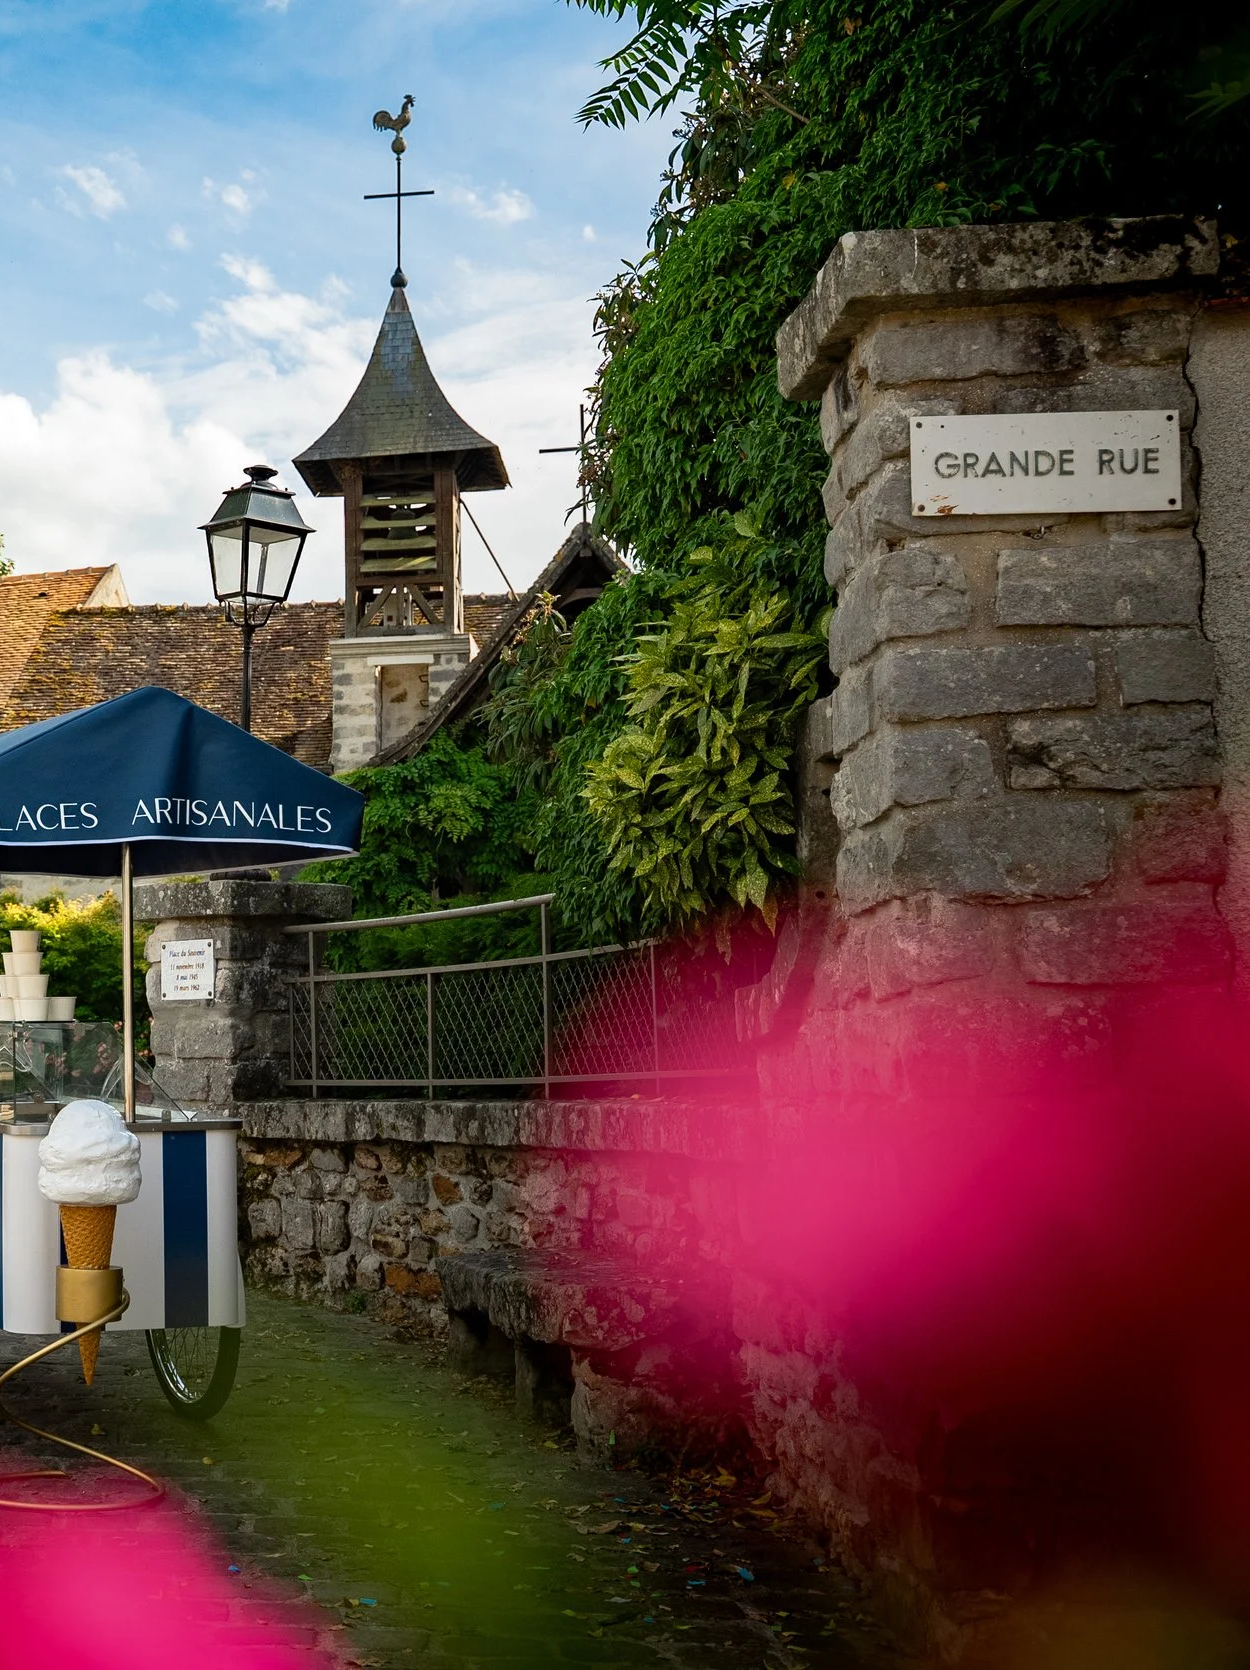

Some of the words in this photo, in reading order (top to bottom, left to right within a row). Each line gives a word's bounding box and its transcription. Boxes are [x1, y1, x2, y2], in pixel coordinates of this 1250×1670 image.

[934, 450, 1075, 478] GRANDE
[1098, 448, 1159, 475] RUE
[132, 798, 332, 833] ARTISANALES
